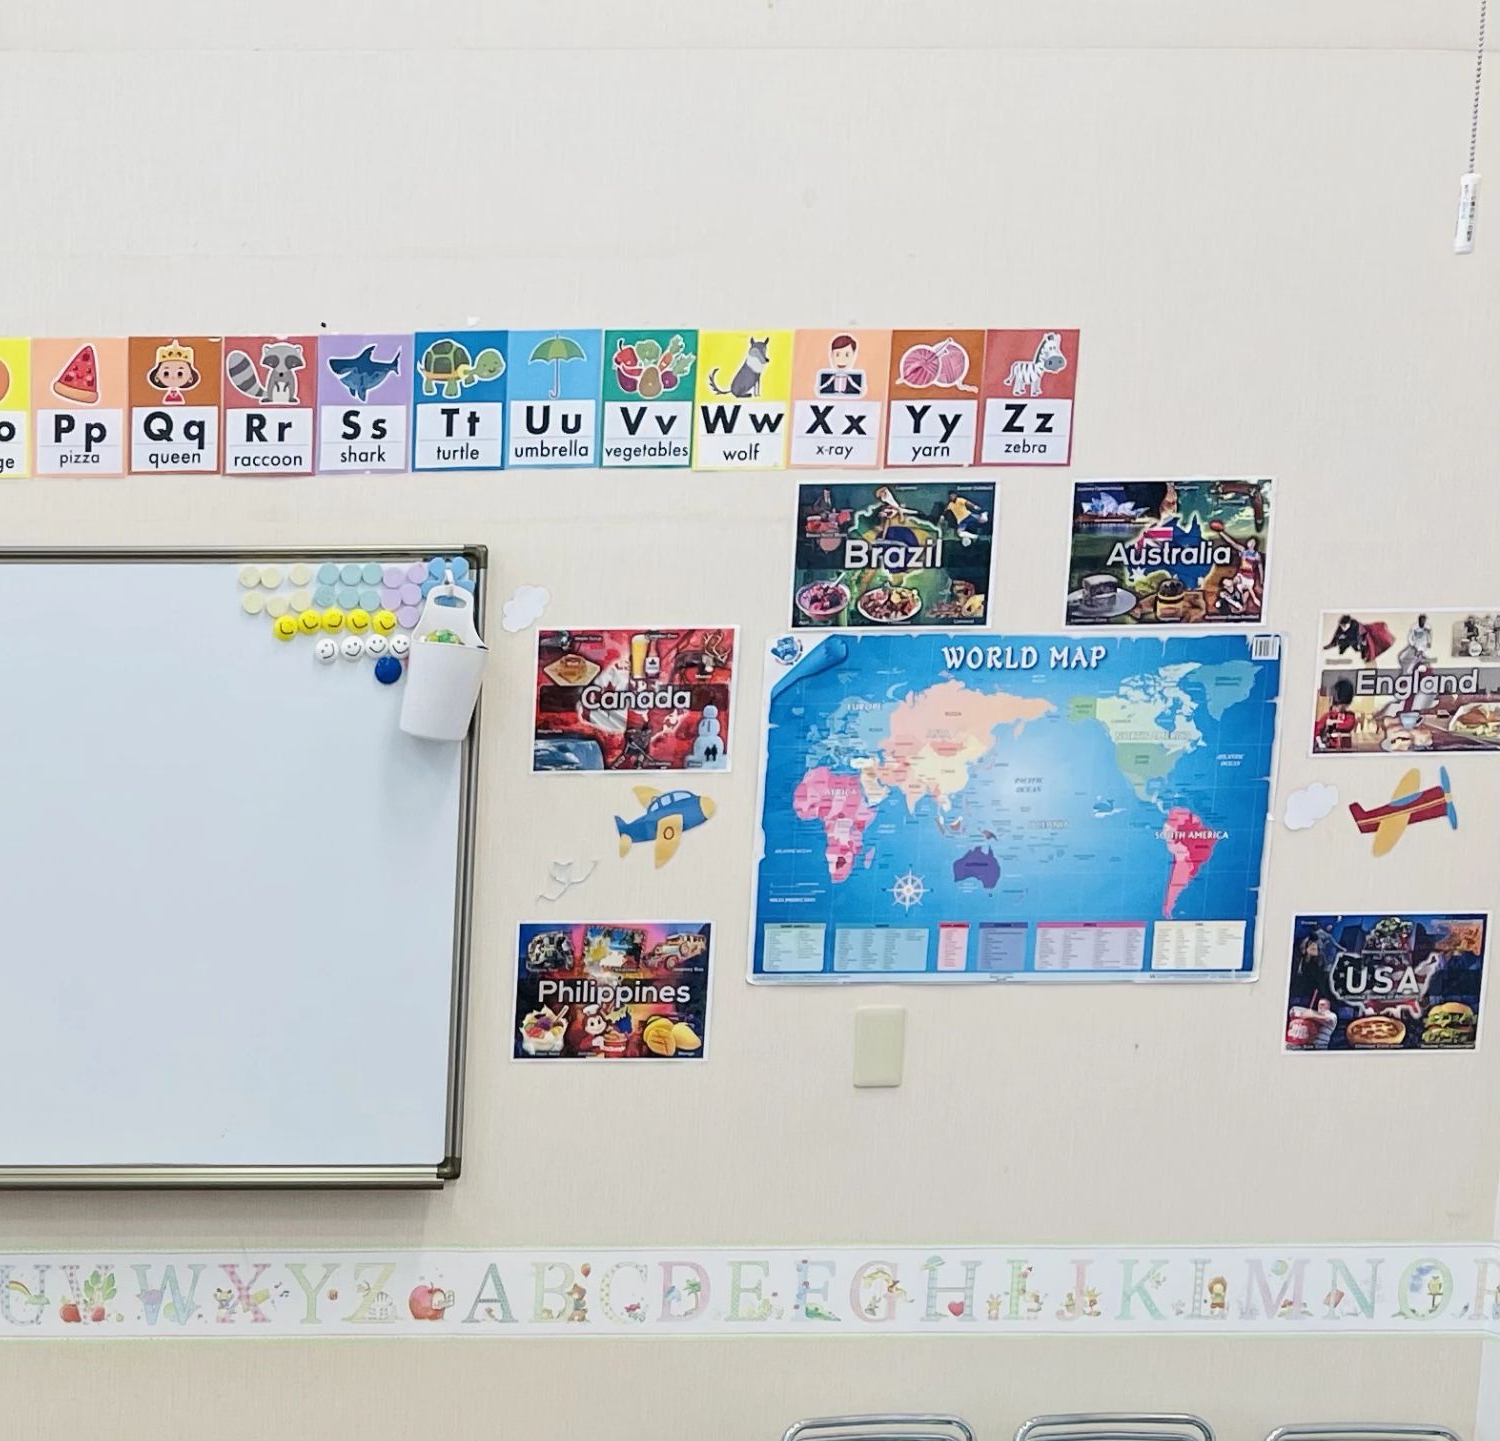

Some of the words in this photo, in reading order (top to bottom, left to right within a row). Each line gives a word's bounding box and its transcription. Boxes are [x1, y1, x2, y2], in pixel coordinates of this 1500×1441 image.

[340, 444, 386, 463] shark
[436, 442, 480, 461] turtle
[514, 439, 589, 458] umbrella
[604, 440, 690, 462] vegetables
[723, 442, 760, 461] wolf
[816, 446, 854, 462] x-ray
[911, 445, 951, 462] yarn
[1004, 438, 1047, 454] zebra
[59, 453, 100, 468] pizza
[148, 453, 201, 471] queen
[233, 454, 303, 467] raccoon
[845, 538, 943, 569] Brazil
[1106, 541, 1232, 566] Australia
[941, 646, 1039, 670] WORLD
[1050, 646, 1107, 670] MAP
[1356, 669, 1479, 700] England
[581, 686, 692, 710] Canada
[1187, 830, 1230, 840] AMERICA
[1345, 965, 1421, 995] USA
[538, 980, 691, 1008] Philippines
